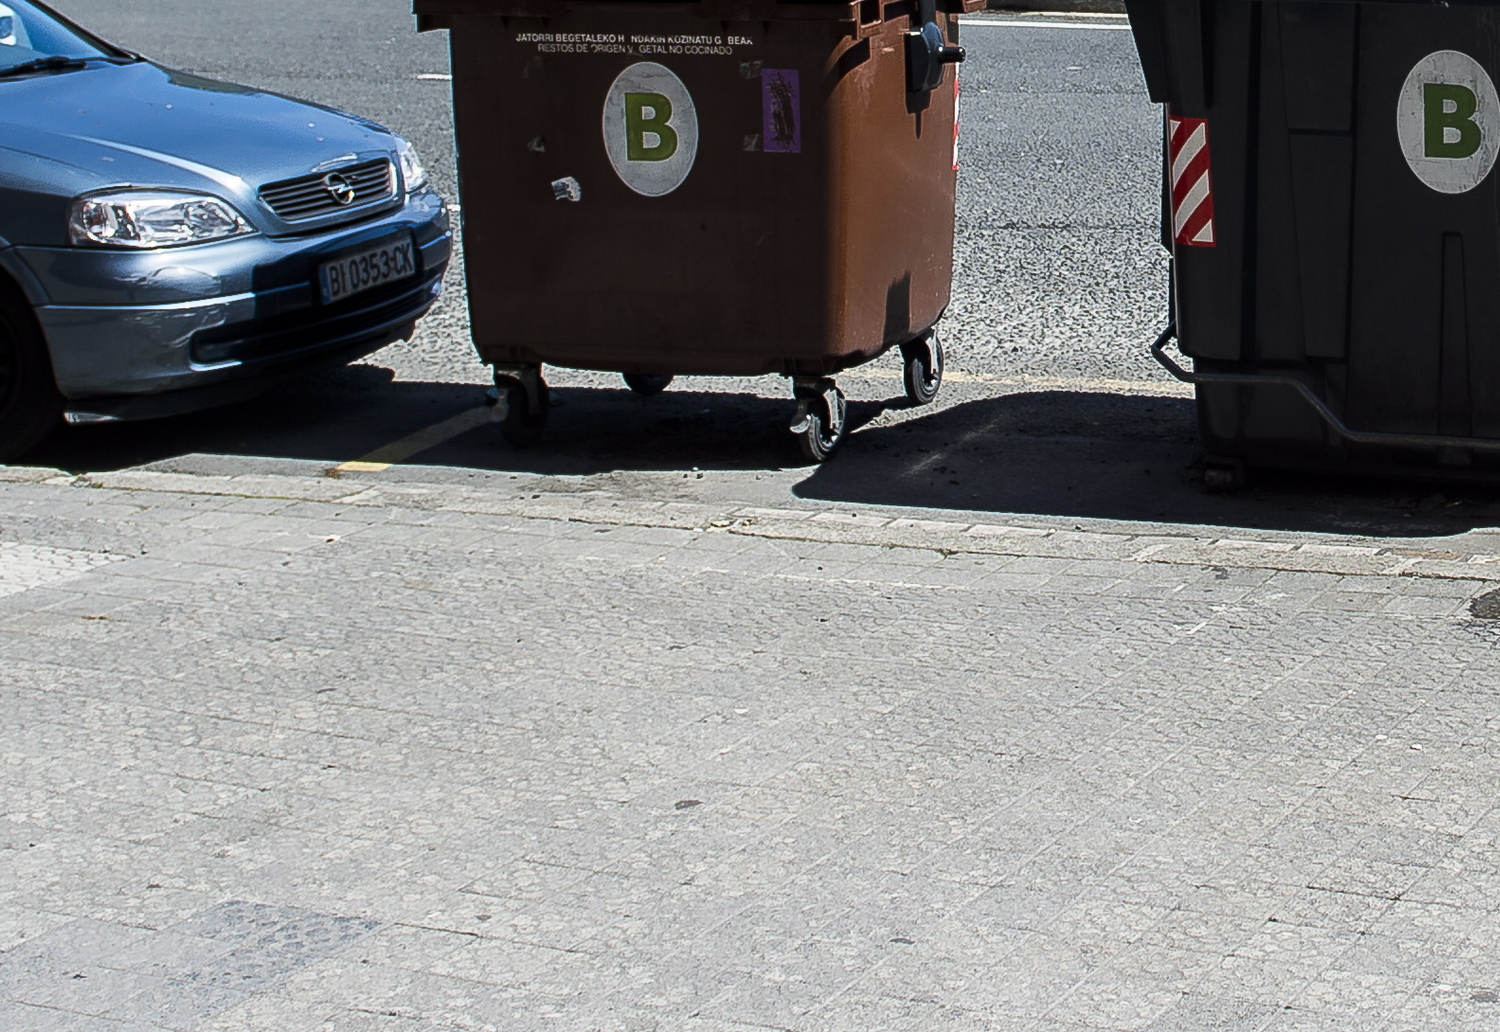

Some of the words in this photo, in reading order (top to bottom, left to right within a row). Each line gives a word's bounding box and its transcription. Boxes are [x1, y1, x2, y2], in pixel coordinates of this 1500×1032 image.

[516, 33, 555, 44] JATORRI
[555, 34, 618, 44] BEGETALEKO
[618, 34, 666, 45] HNDAKIN
[714, 35, 754, 46] GBEAK
[538, 44, 575, 54] RESTOS
[576, 44, 589, 54] DE
[626, 44, 668, 55] VGETAL
[669, 45, 683, 55] NO
[684, 45, 734, 56] COCINADO
[624, 91, 679, 162] B
[1423, 82, 1482, 158] B
